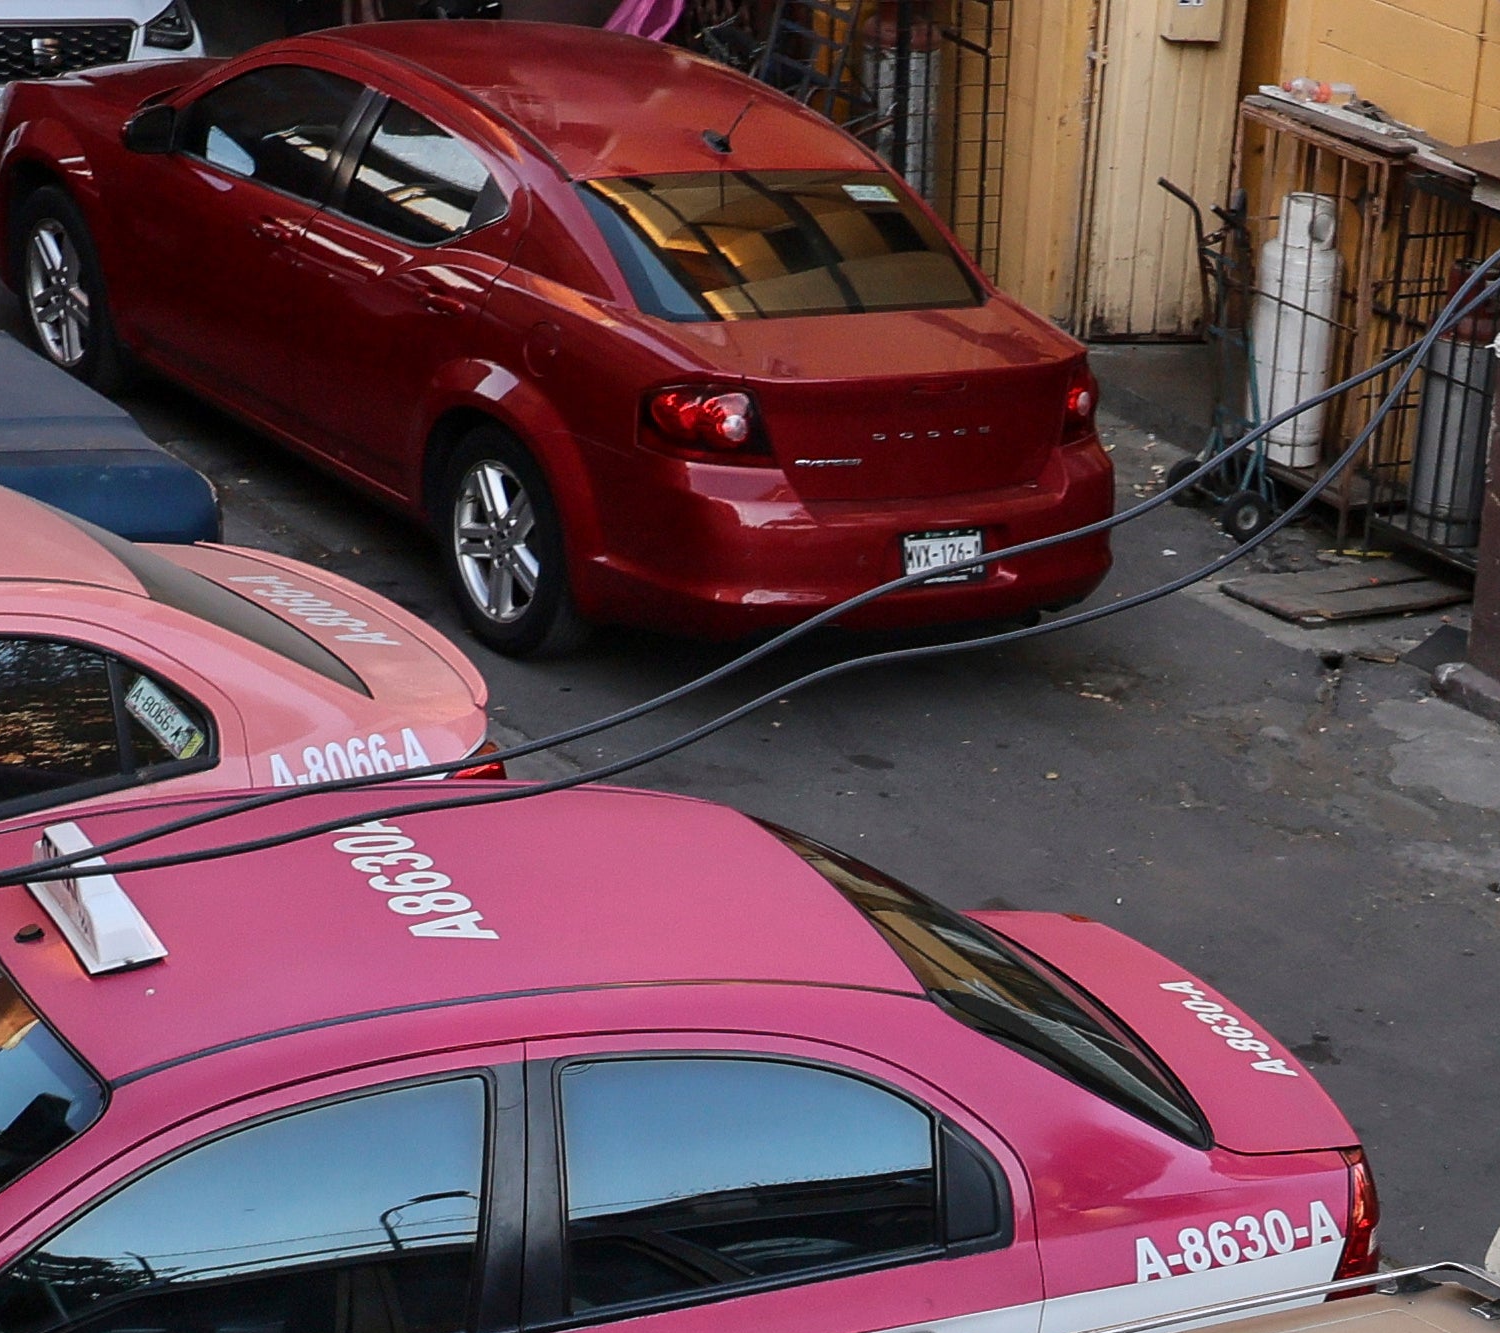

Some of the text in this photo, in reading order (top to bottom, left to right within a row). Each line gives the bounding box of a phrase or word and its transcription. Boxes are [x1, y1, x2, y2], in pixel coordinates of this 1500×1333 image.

[227, 576, 402, 646] A-8066-A
[269, 727, 431, 787] A-8066-A
[1159, 981, 1299, 1077] A-8630-A
[1134, 1200, 1342, 1283] A-8630-A
